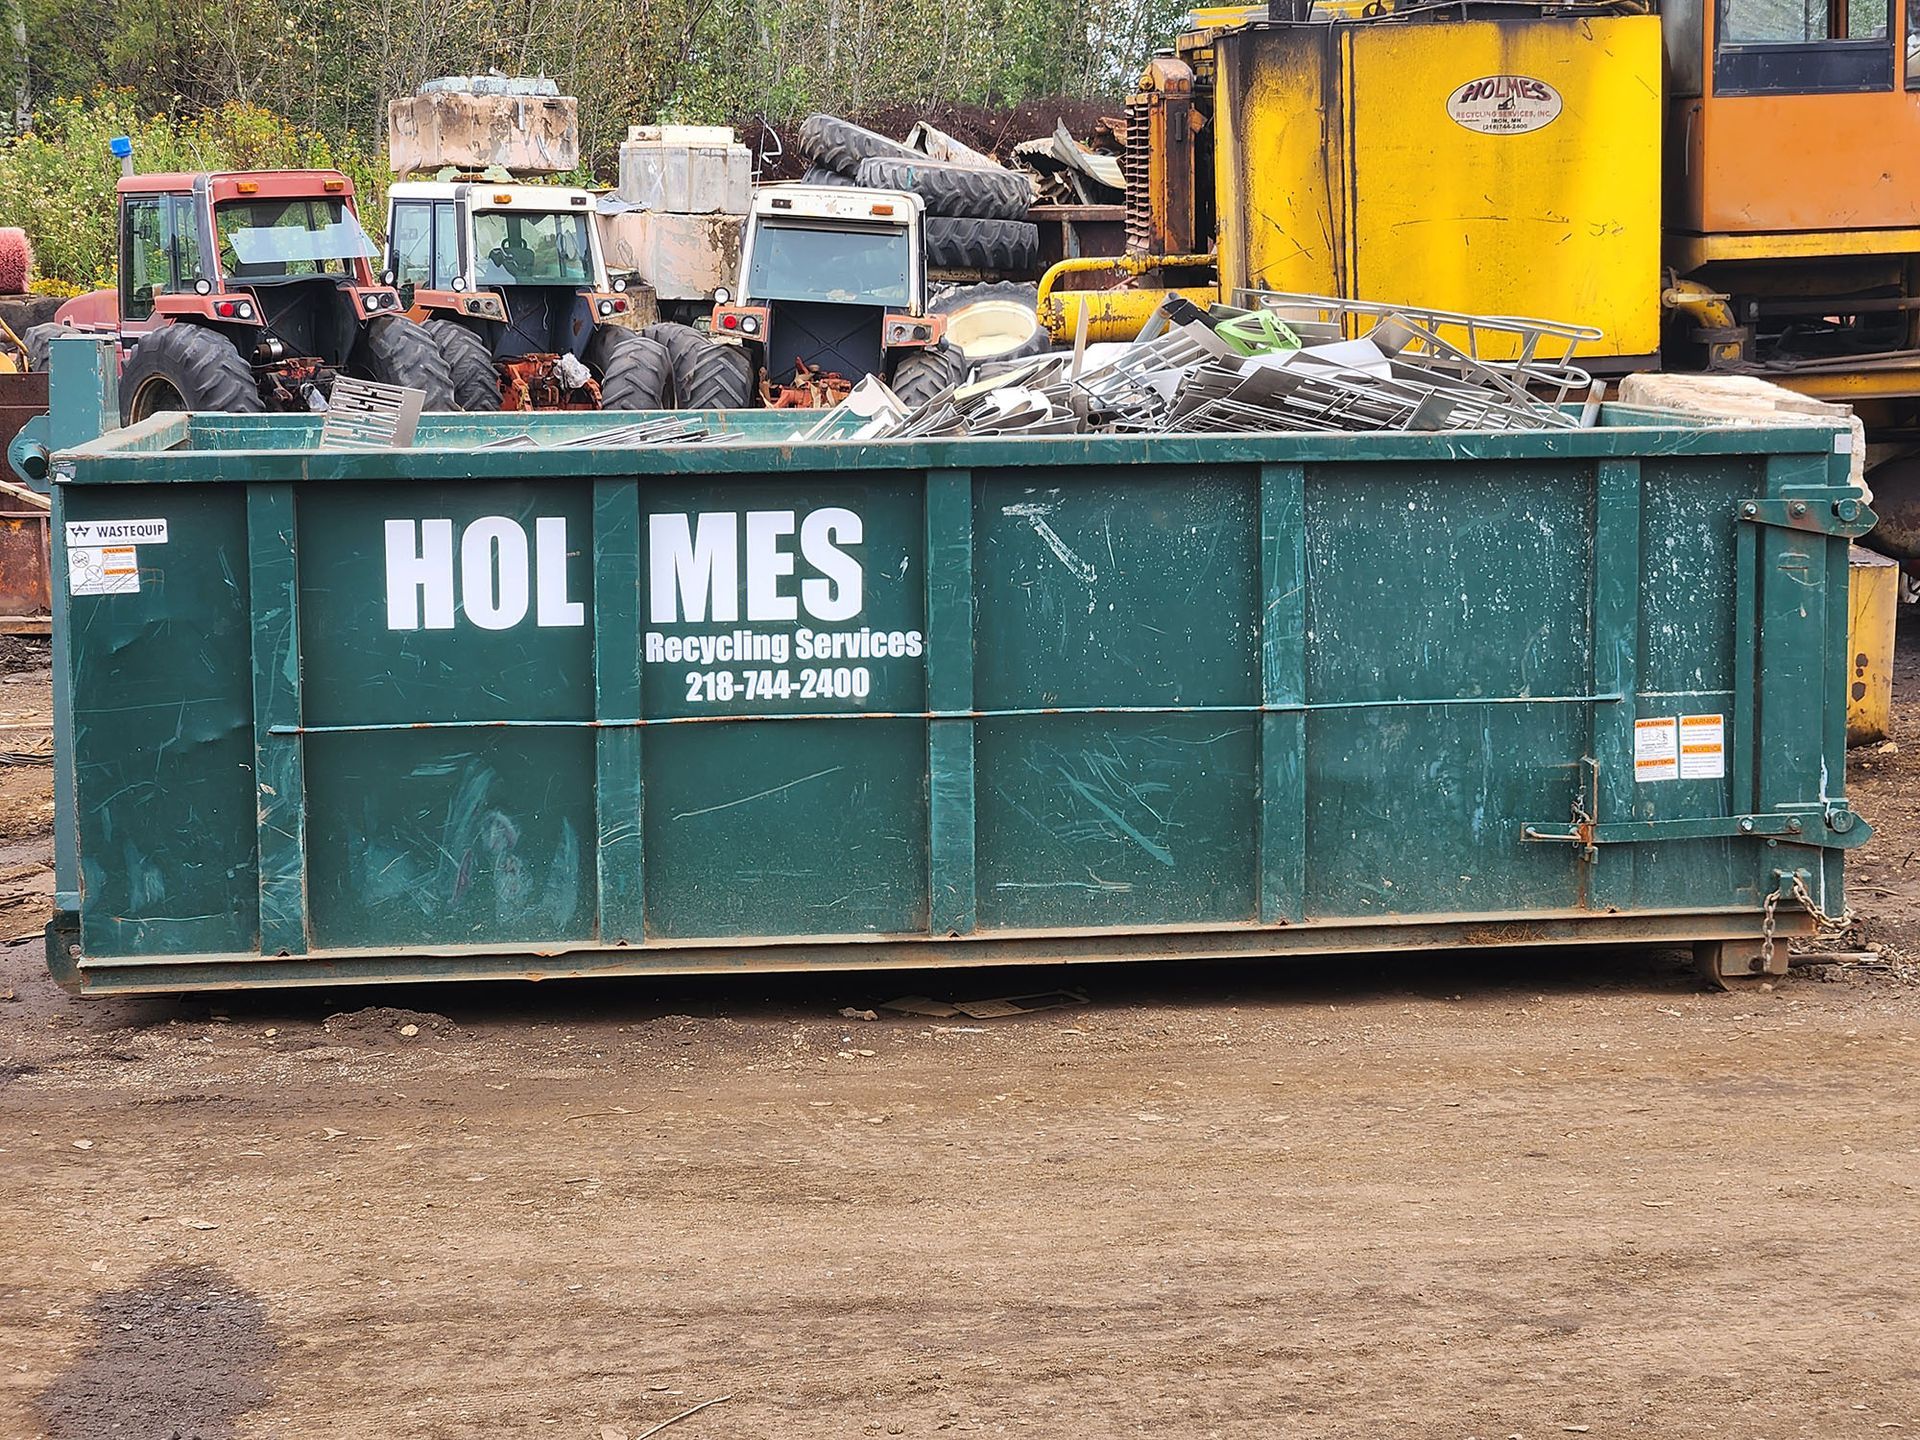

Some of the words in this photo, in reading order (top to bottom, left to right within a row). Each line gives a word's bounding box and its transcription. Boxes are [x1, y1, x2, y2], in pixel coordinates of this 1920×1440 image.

[1458, 78, 1552, 104] HOLMES
[1456, 111, 1497, 119] RECYCLING
[97, 525, 165, 537] WASTEQUIP
[645, 630, 790, 665] Recycling
[795, 627, 923, 660] Services
[686, 667, 870, 701] 218-744-2400
